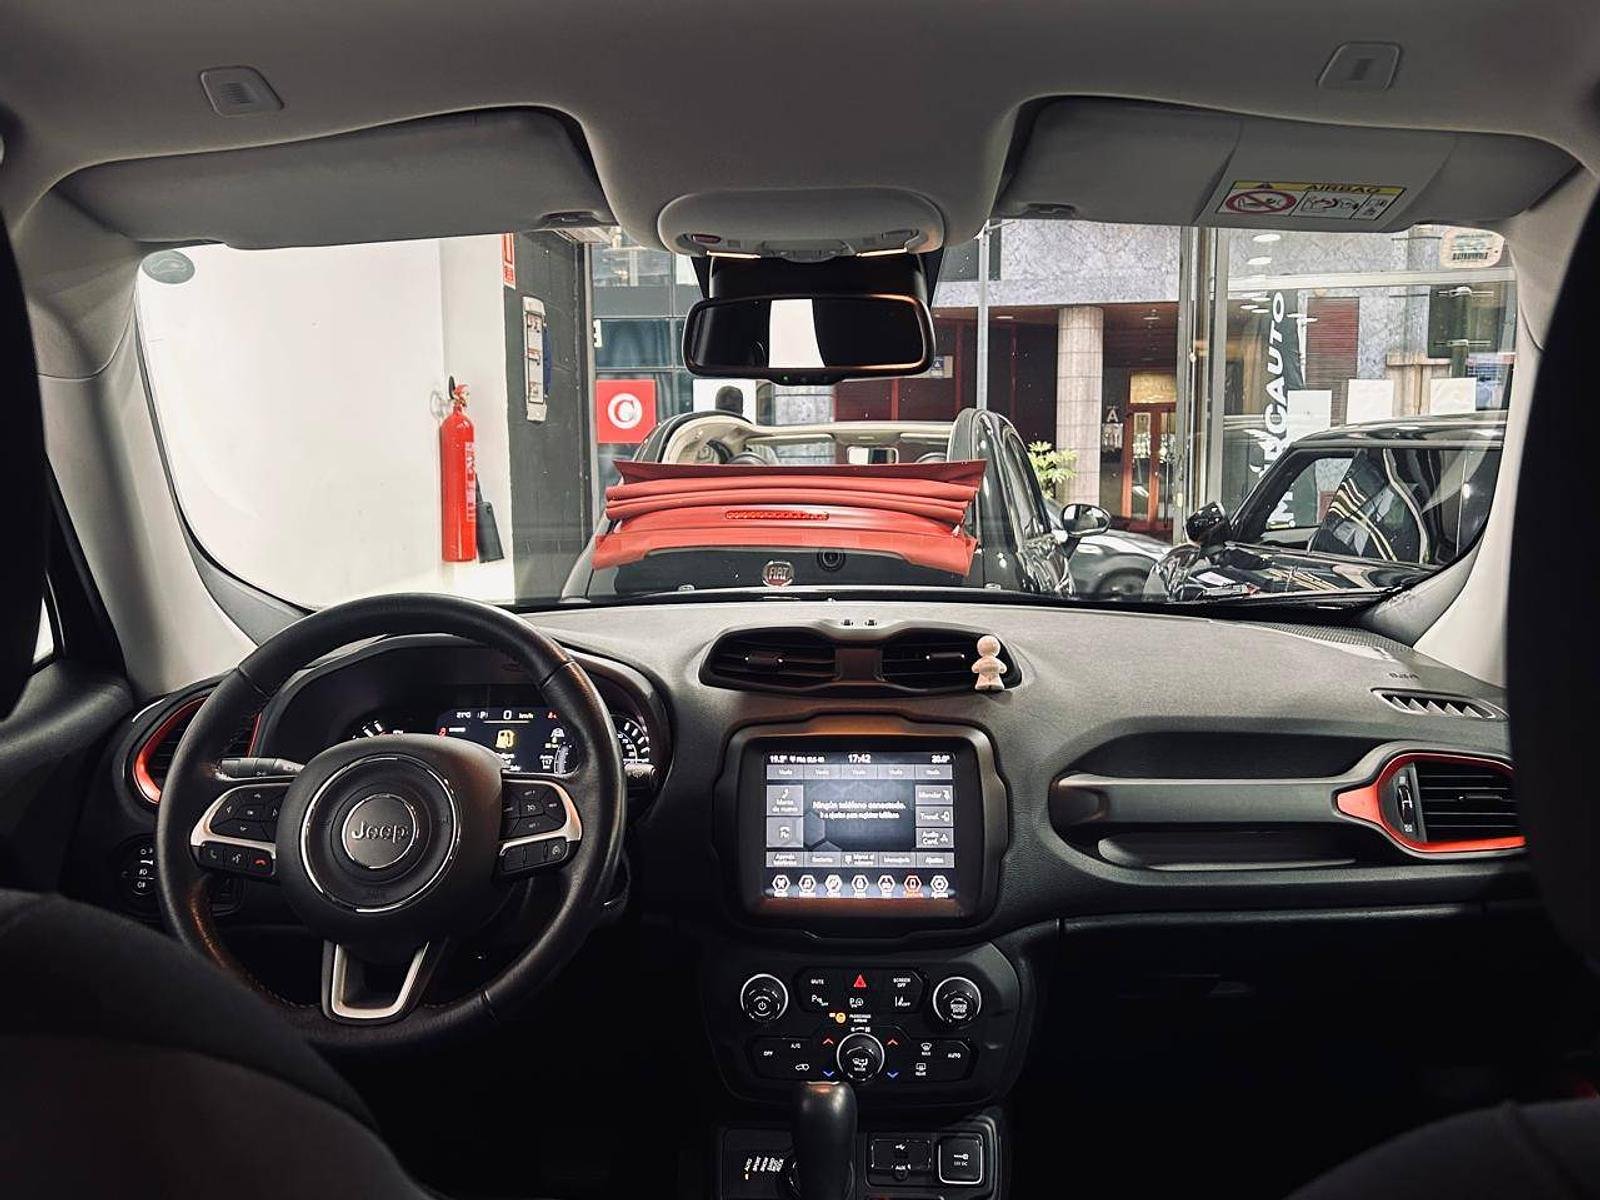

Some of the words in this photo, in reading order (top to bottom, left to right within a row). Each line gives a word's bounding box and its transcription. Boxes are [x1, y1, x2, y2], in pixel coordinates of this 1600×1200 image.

[1304, 183, 1380, 194] AIRBAG
[1263, 292, 1295, 522] MRCAUTO
[767, 566, 789, 580] FIAT
[848, 754, 871, 764] 17:42
[351, 821, 405, 843] Jeep
